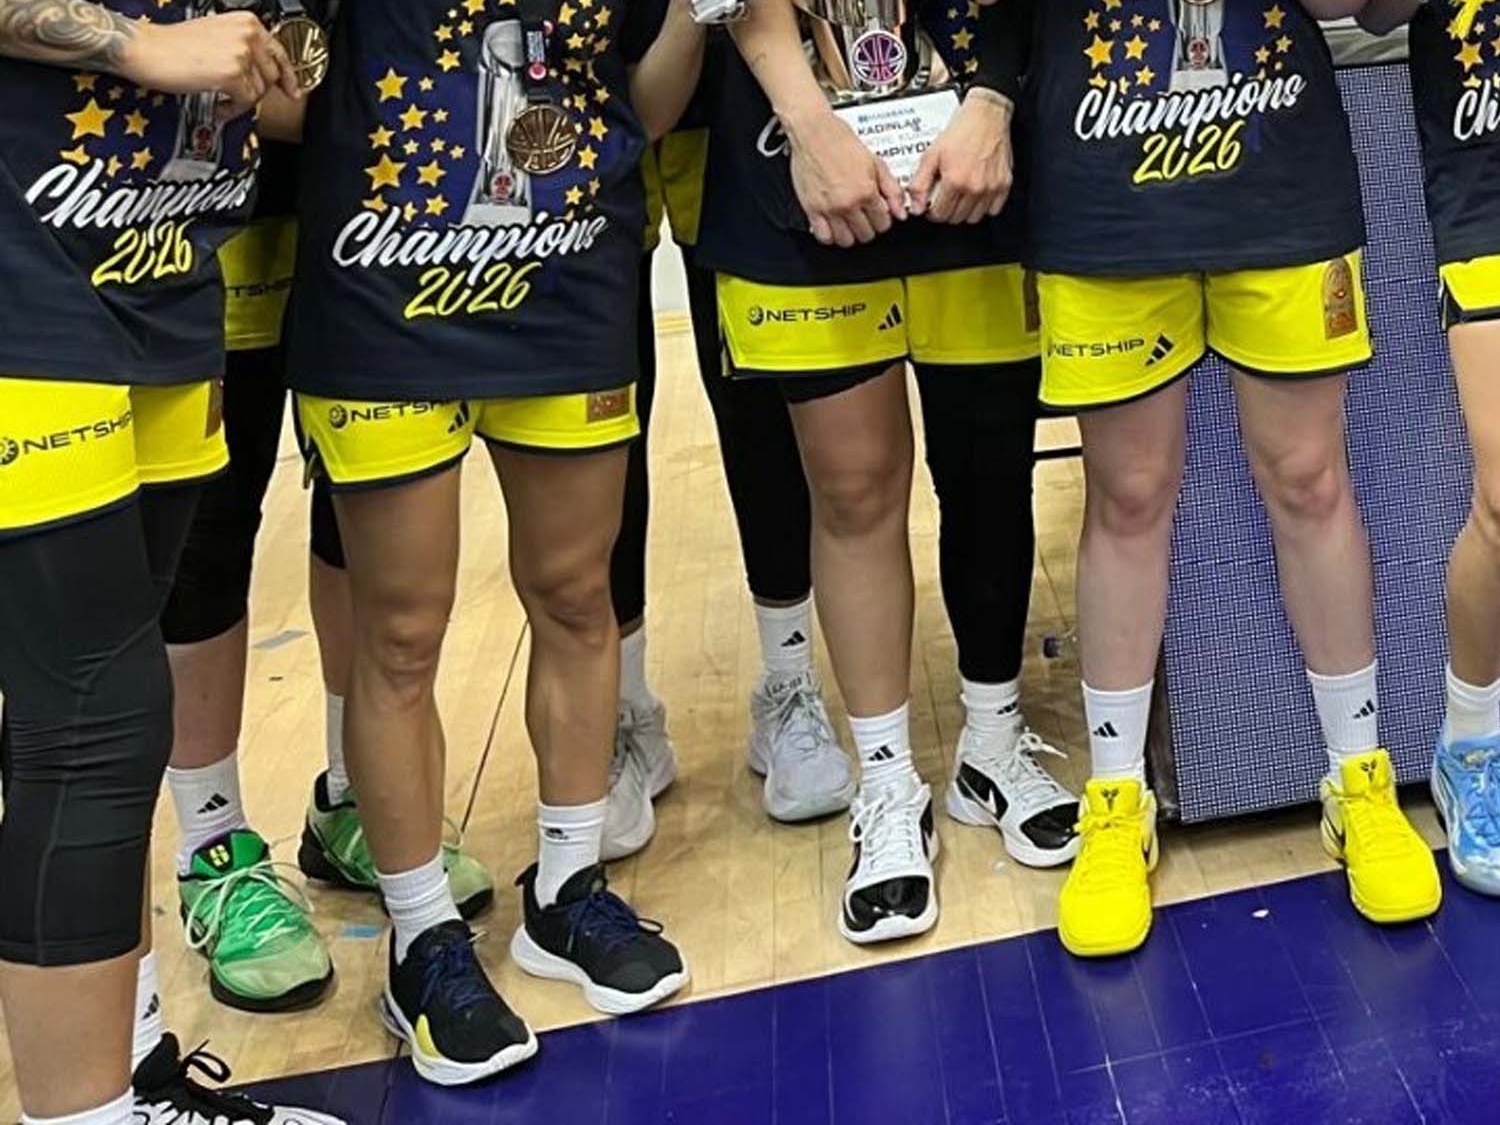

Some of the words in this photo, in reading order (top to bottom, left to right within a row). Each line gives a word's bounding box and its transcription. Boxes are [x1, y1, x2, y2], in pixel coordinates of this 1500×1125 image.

[1074, 71, 1308, 148] Champions
[1132, 118, 1247, 187] 2026
[24, 157, 259, 247] Champions
[92, 217, 194, 287] 2026
[332, 205, 609, 287] Champions
[402, 261, 544, 320] 2026
[766, 302, 867, 323] NETSHIP
[1050, 337, 1145, 359] NETSHIP
